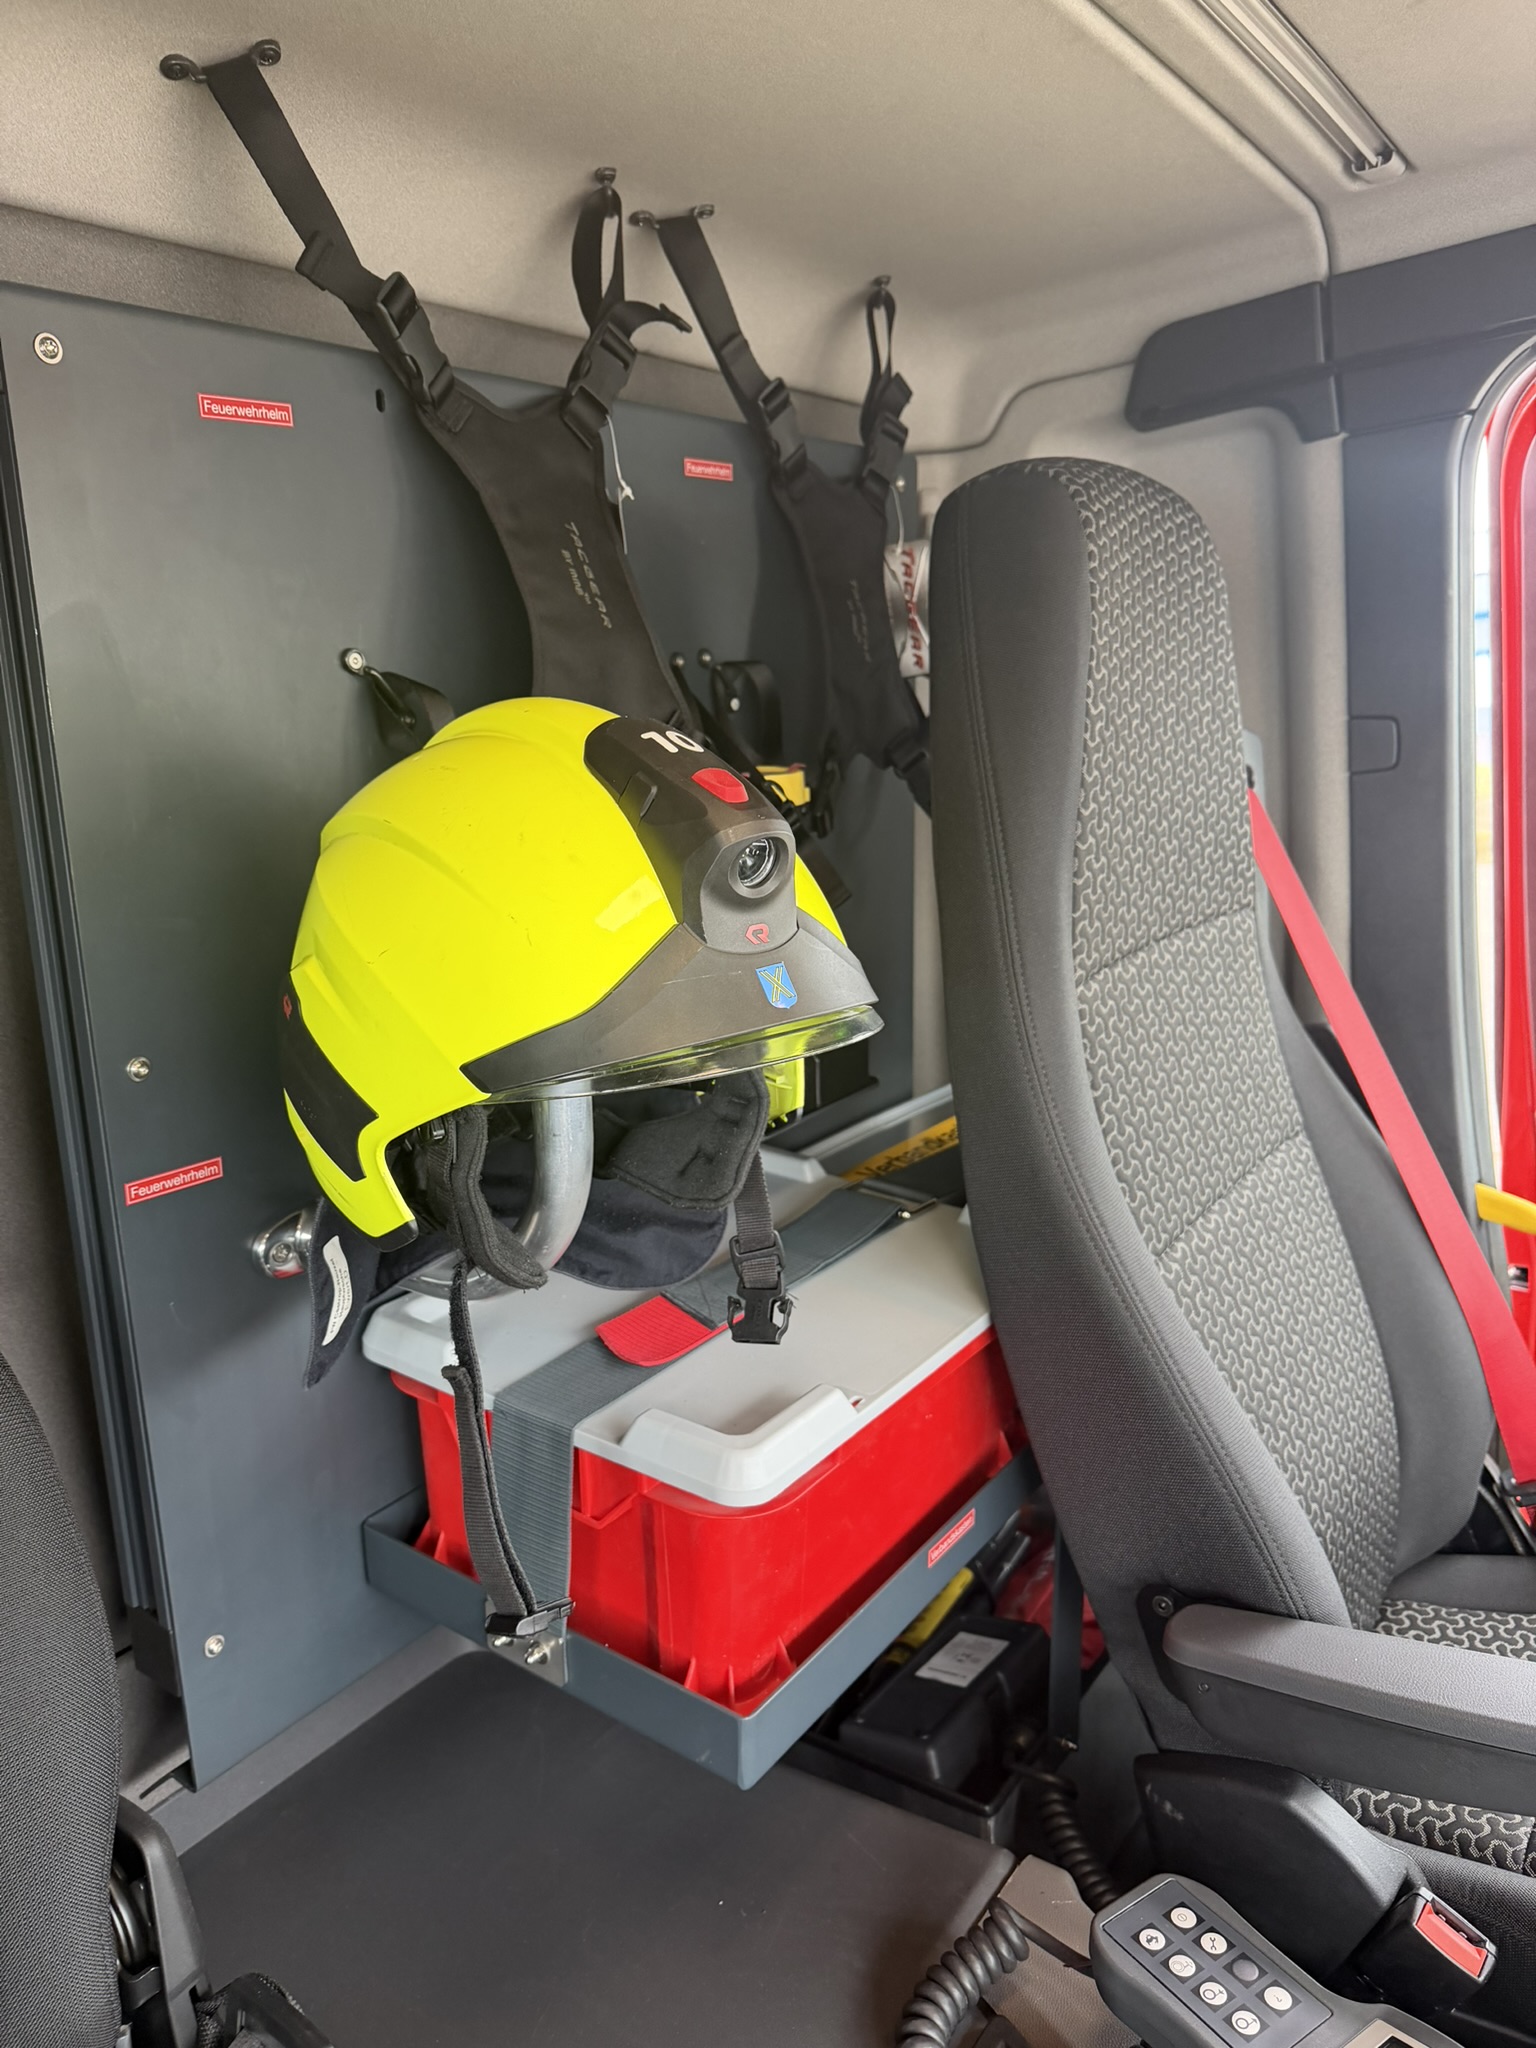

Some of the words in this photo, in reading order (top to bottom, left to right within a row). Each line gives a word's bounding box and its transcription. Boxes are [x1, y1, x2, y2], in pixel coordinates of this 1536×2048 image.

[203, 399, 290, 422] Feuerwehrhelm
[565, 522, 612, 629] TACGEAR
[640, 730, 705, 754] 10
[130, 1165, 219, 1199] Feuerwehrhelm
